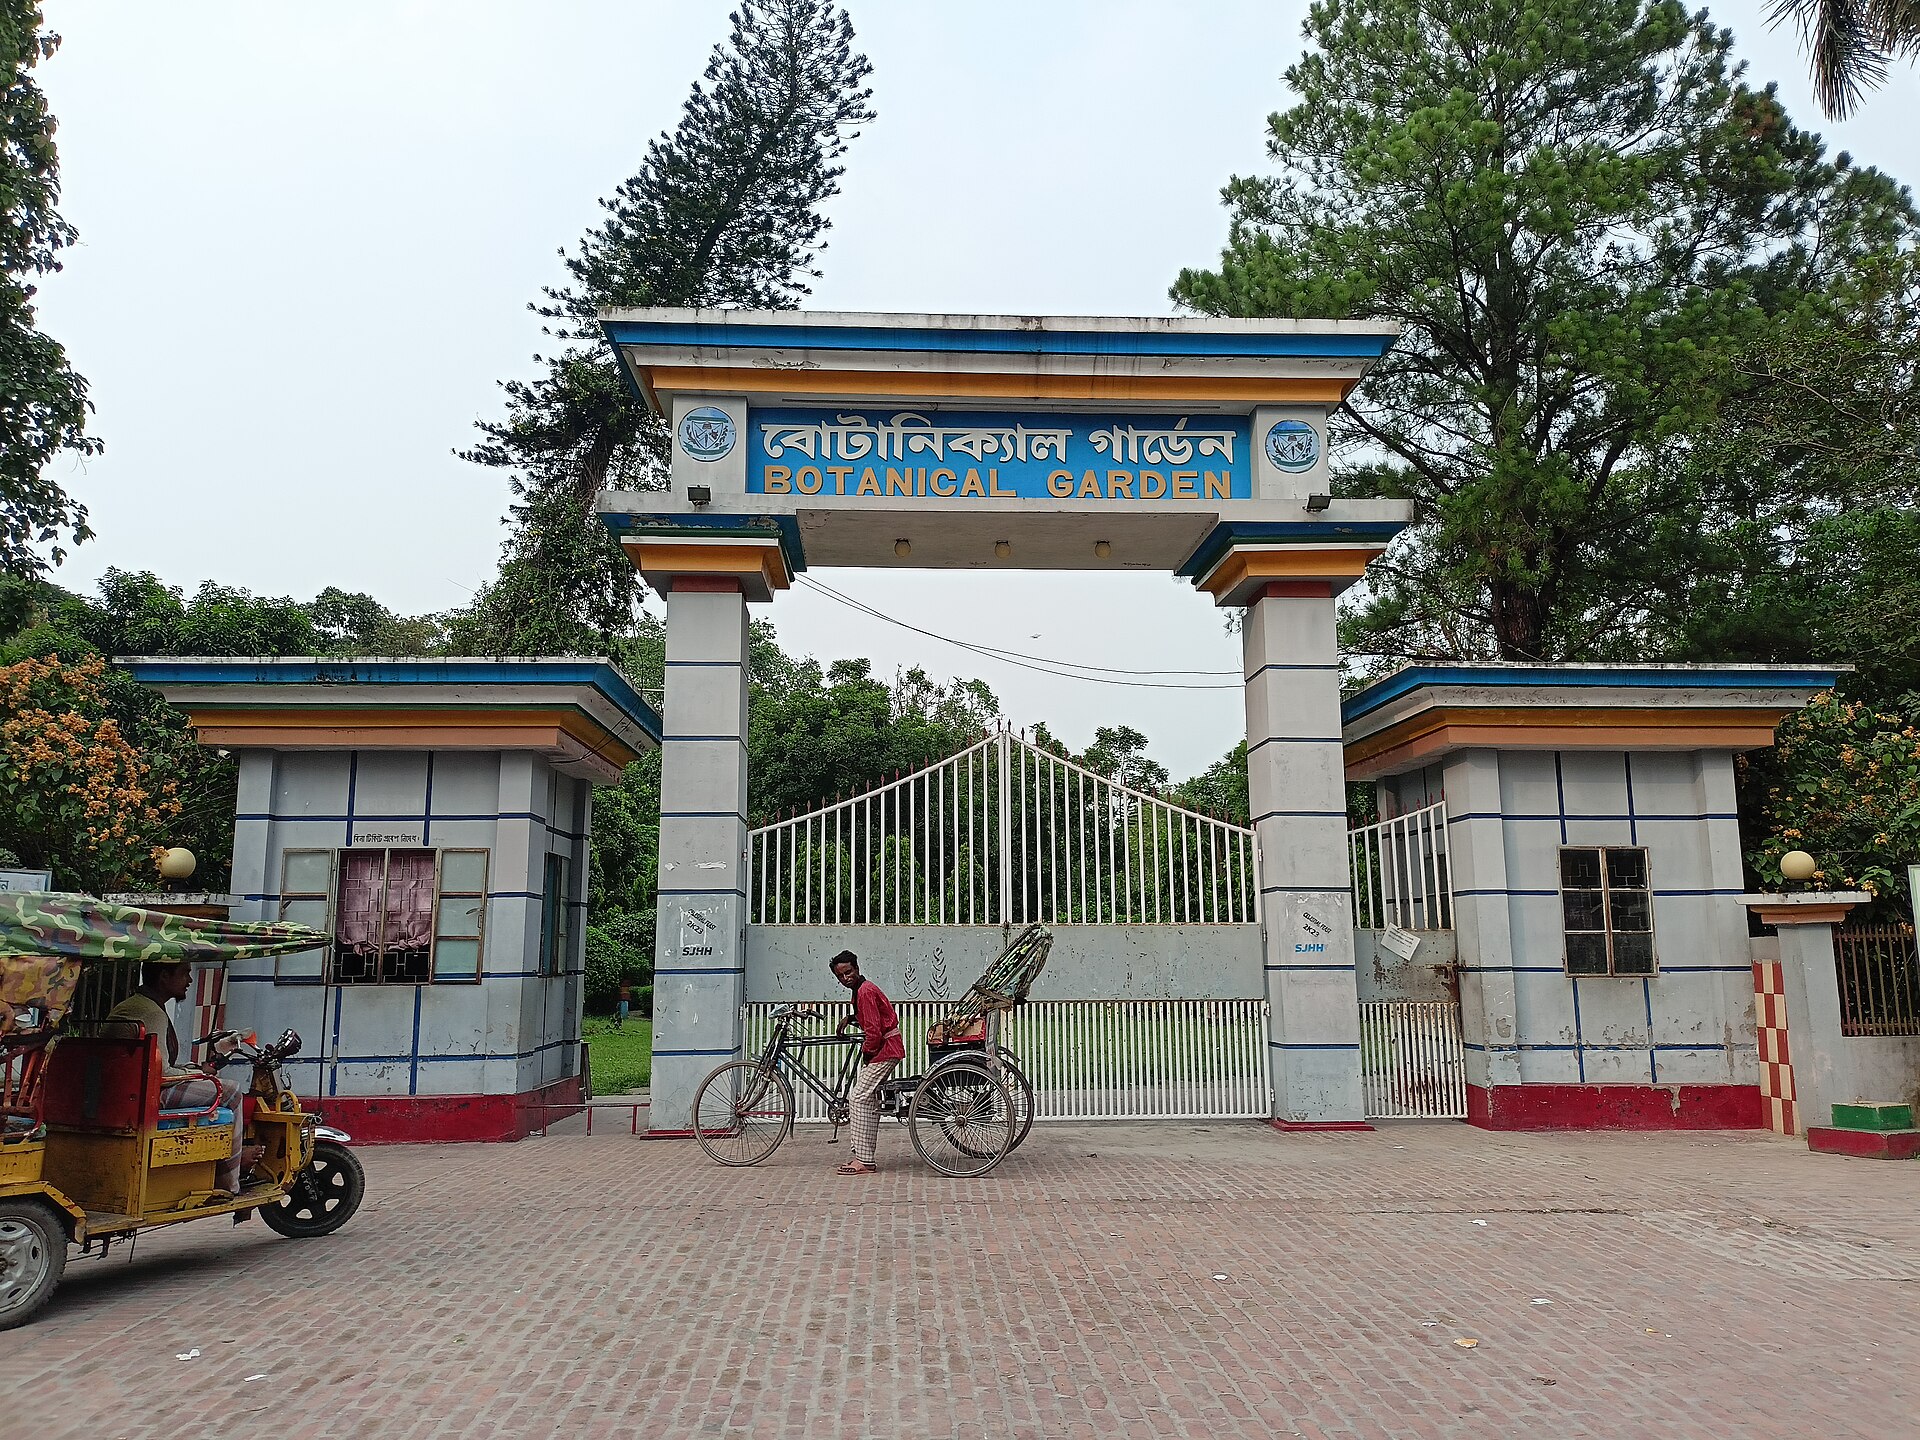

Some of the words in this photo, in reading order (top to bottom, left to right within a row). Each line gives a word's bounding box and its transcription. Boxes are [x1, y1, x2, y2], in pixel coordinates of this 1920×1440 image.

[760, 412, 1073, 463] বোটানিক্যাল
[1088, 416, 1237, 465] গার্ডেন
[764, 465, 1017, 497] BOTANICAL
[1047, 469, 1231, 500] GARDEN
[686, 920, 704, 935] 2K23
[1302, 923, 1320, 938] 2K23
[682, 946, 713, 956] SJHH
[1294, 943, 1325, 953] SJHH
